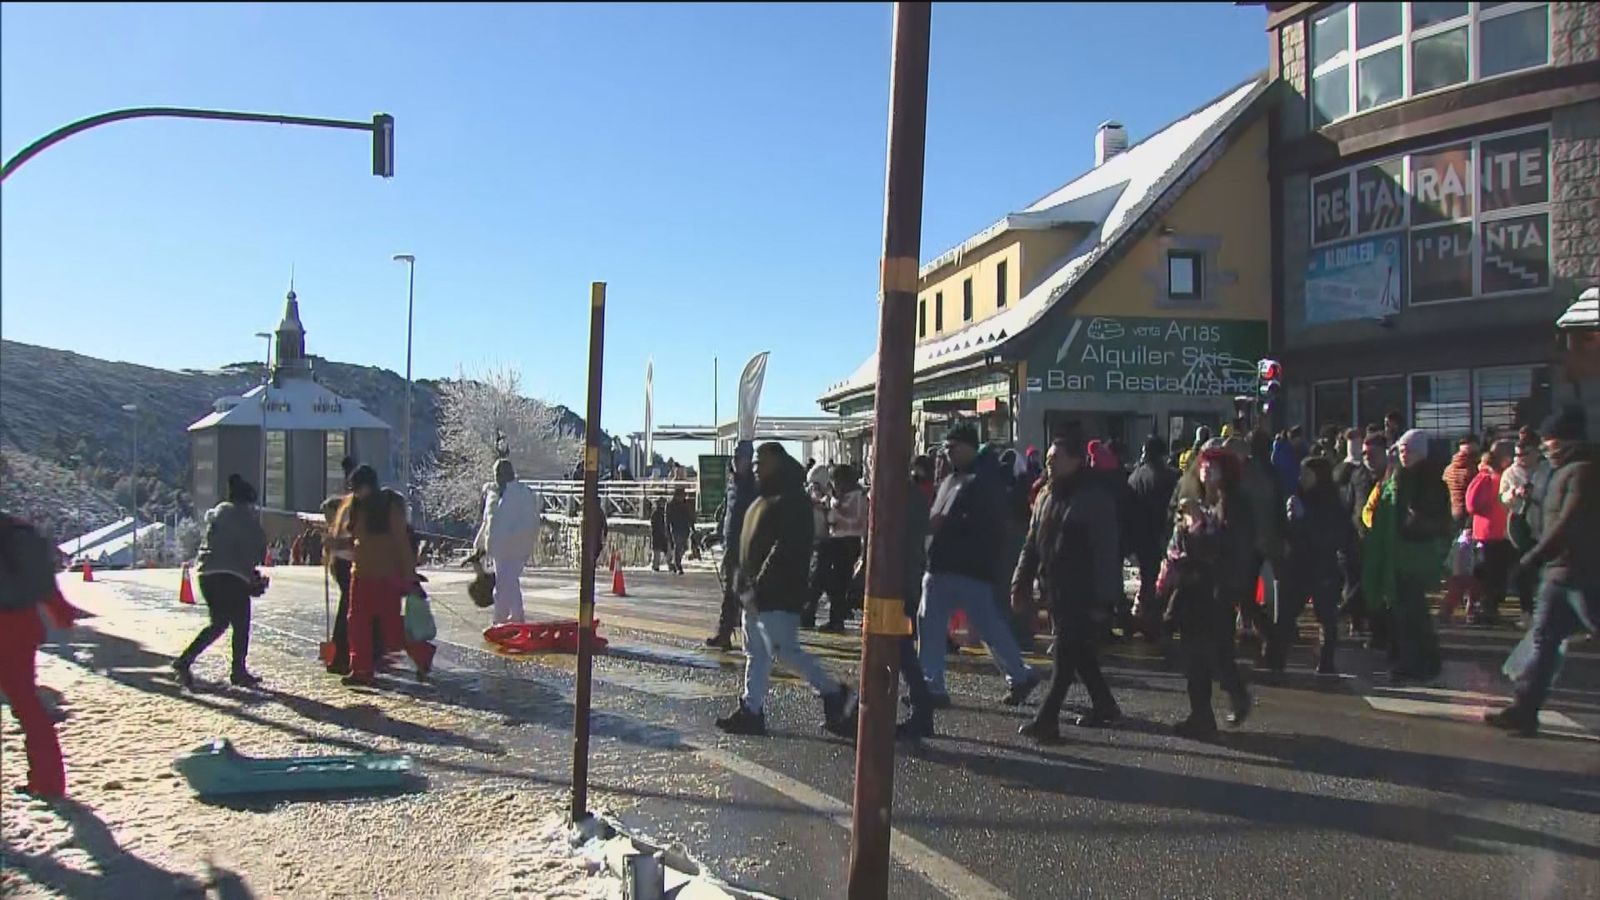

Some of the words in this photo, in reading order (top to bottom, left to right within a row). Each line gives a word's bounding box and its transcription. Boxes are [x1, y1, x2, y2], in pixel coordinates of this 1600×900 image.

[1164, 319, 1220, 342] Arias
[1080, 343, 1175, 369] Alquiler
[1047, 370, 1095, 390] Bar
